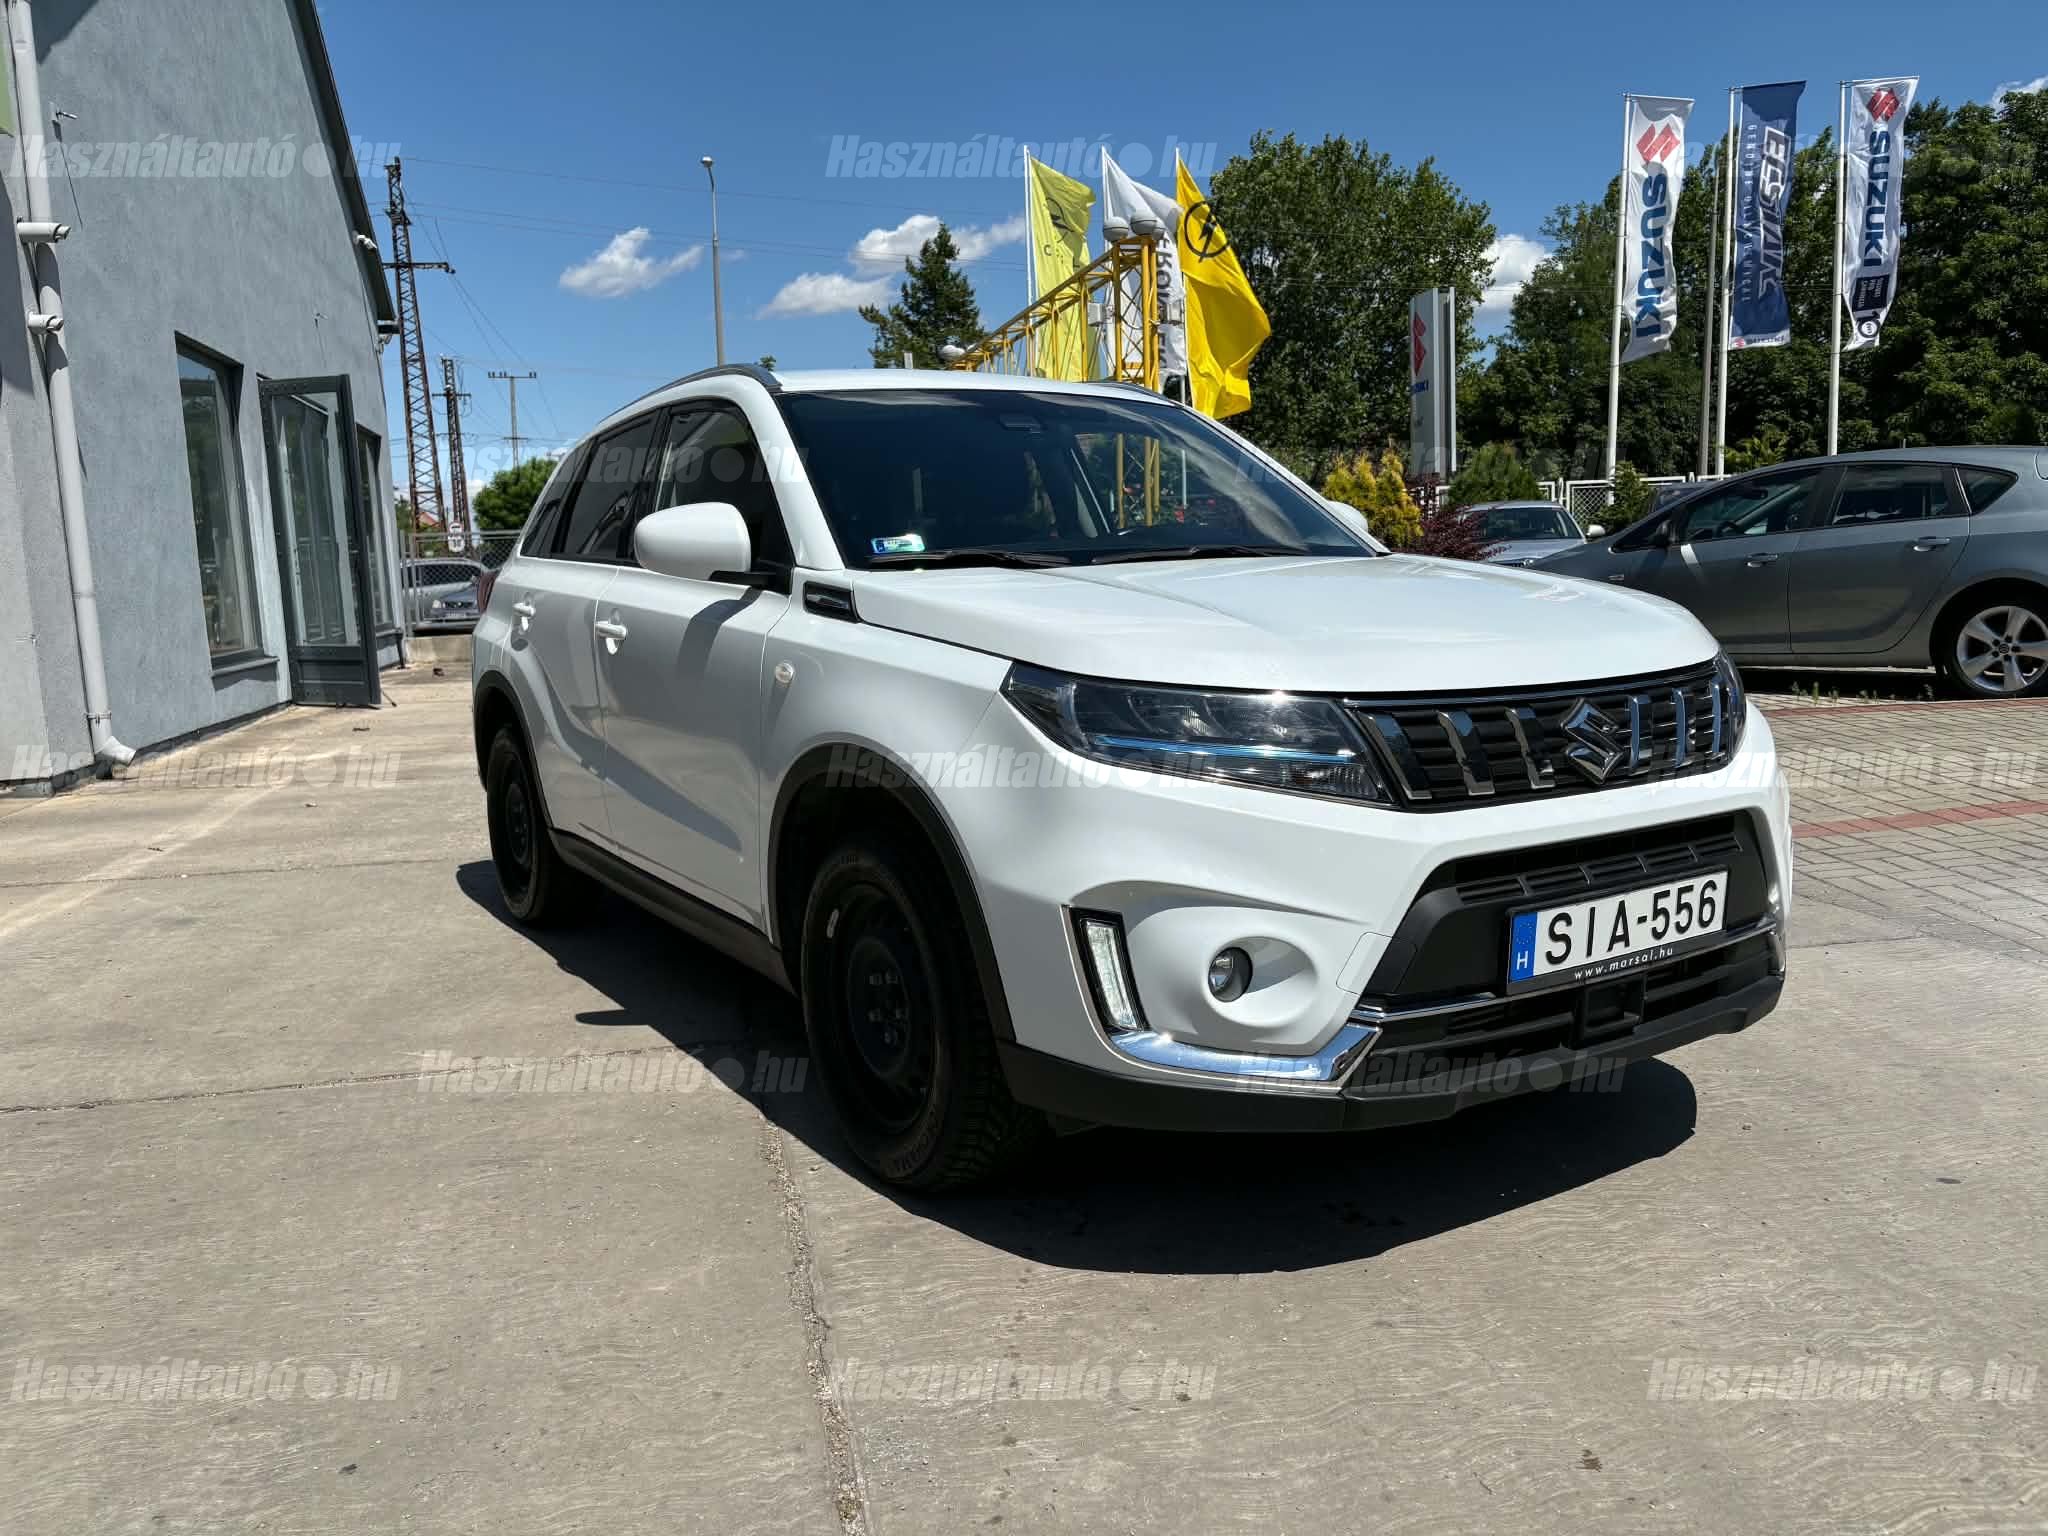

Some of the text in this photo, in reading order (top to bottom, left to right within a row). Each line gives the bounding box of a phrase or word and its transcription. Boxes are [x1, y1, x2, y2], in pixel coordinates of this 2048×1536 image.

[1864, 130, 1890, 267] SUZUKI
[1635, 172, 1667, 338] SUZUKI
[1516, 951, 1528, 971] H
[1545, 879, 1717, 965] SIA-556
[1574, 946, 1674, 980] www.marsal.hu
